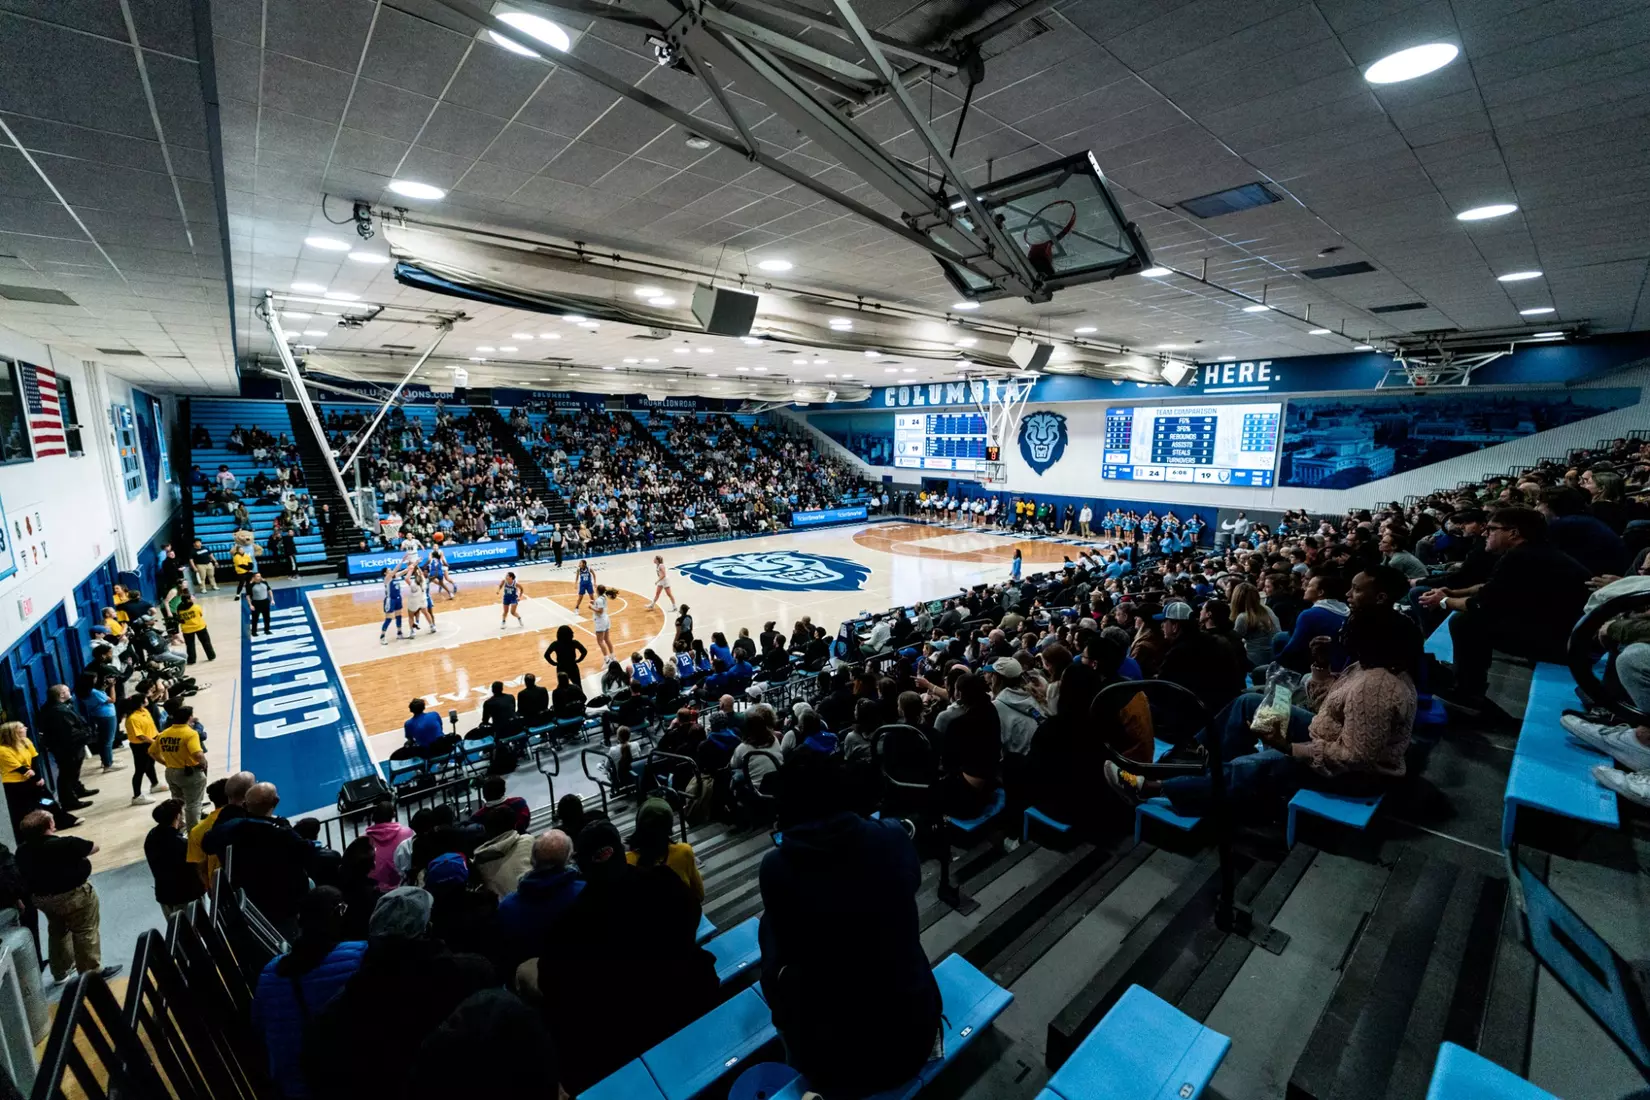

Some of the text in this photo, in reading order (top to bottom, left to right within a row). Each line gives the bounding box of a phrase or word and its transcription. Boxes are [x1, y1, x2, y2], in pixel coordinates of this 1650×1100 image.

[1204, 361, 1281, 385] HERE.
[885, 380, 1021, 407] COLUMBIA
[452, 546, 508, 559] TicketSmarter
[680, 656, 690, 666] 12
[250, 606, 341, 739] COLUMBIA
[637, 667, 648, 677] 21
